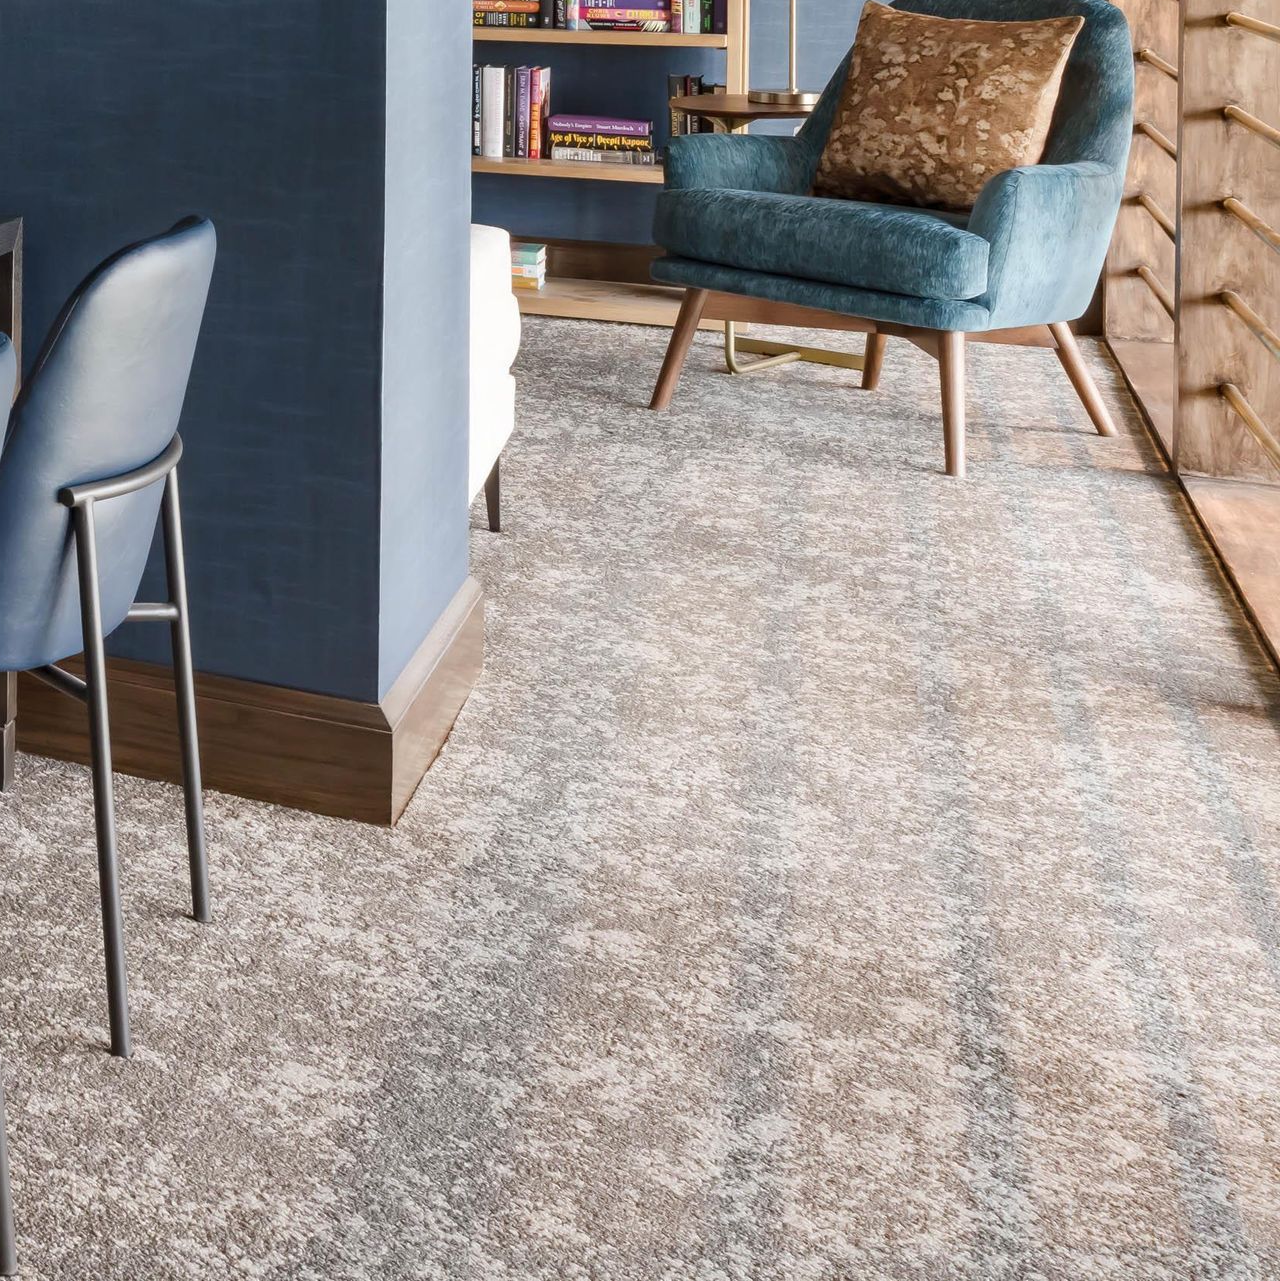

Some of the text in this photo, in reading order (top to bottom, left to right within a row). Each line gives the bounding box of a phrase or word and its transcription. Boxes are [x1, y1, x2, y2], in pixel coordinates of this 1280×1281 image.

[550, 133, 649, 147] Age of Vice Deepti Kapoor
